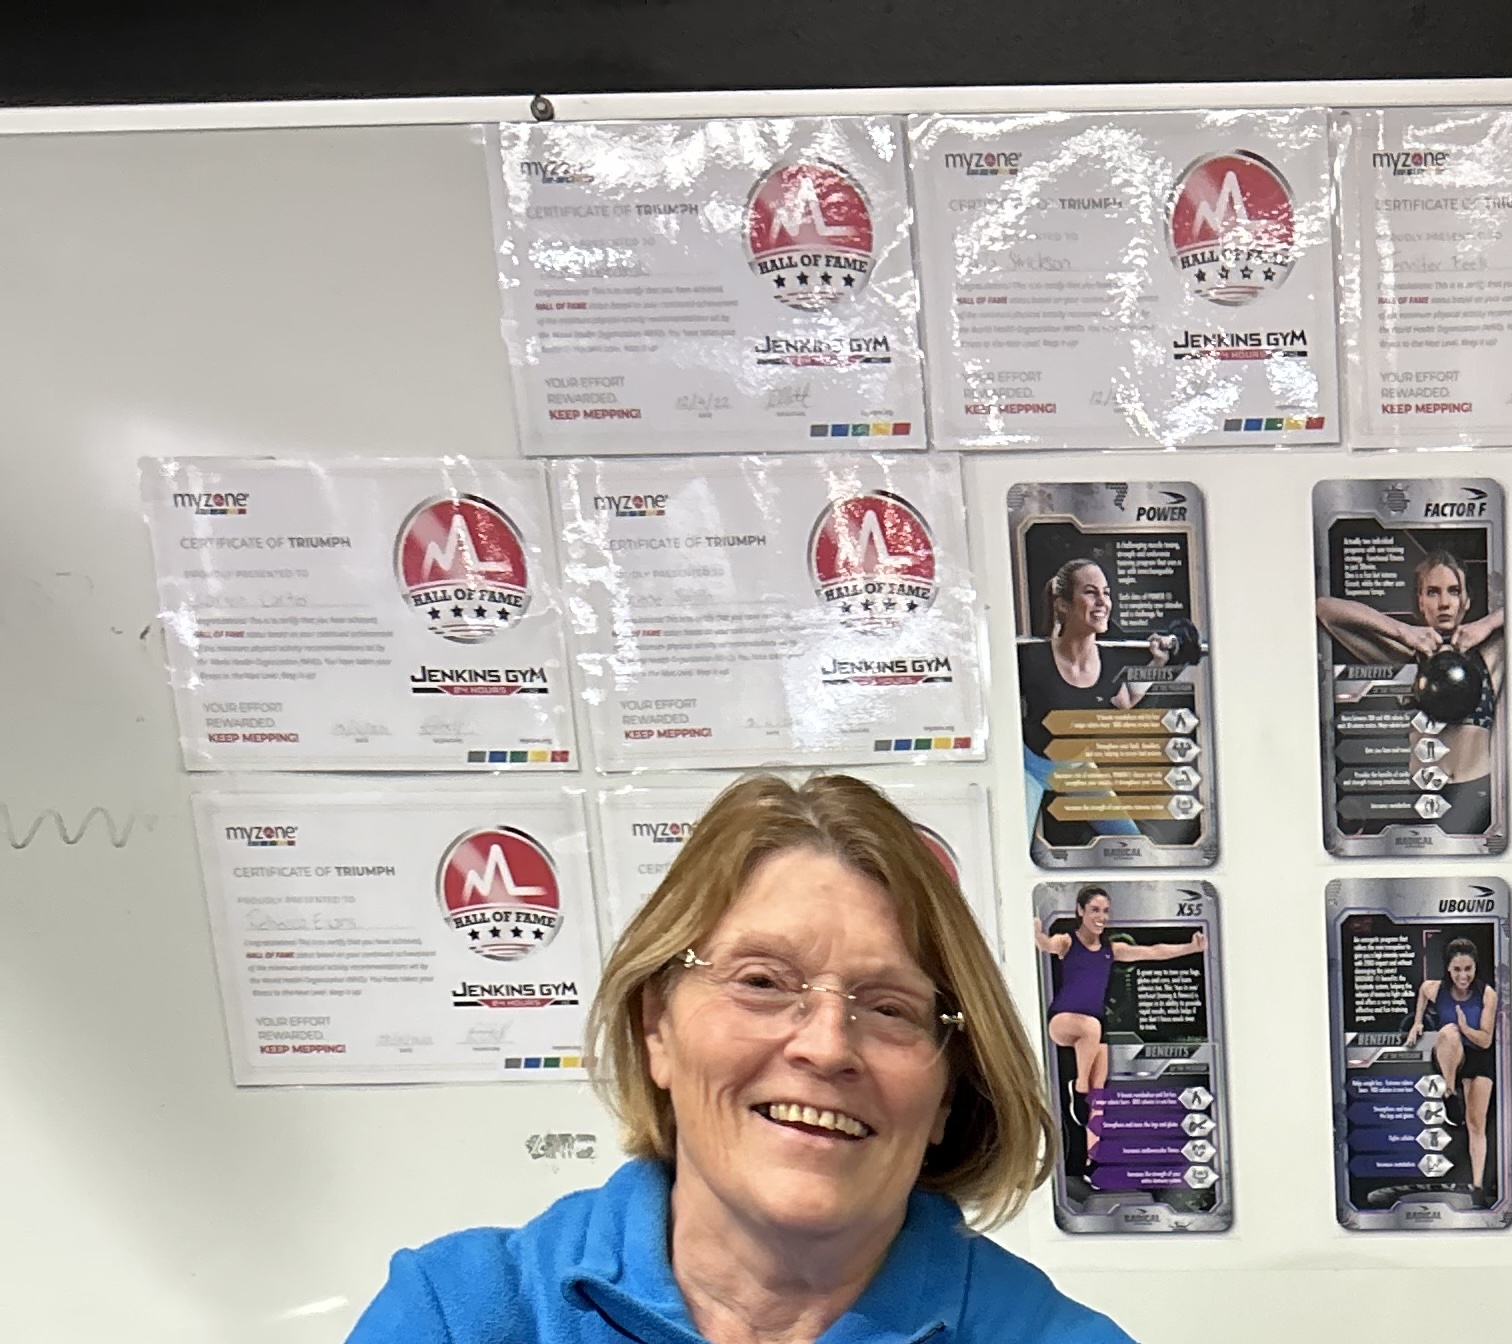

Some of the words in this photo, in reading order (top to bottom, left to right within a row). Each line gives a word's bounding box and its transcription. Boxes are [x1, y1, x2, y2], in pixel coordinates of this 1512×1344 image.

[758, 258, 797, 274] HALL
[801, 255, 821, 267] OF
[825, 255, 868, 272] FAME
[849, 336, 891, 352] GYM
[1173, 331, 1262, 348] JENKINS
[1266, 330, 1307, 347] GYM
[549, 409, 590, 421] KEEP
[595, 408, 642, 420] MEPPING!
[1381, 403, 1412, 414] KEEP
[1416, 402, 1472, 414] MEPPING!
[173, 493, 250, 510] myzone
[1136, 507, 1186, 521] POWER
[1424, 503, 1475, 517] FACTOR
[1479, 503, 1486, 517] F
[413, 590, 451, 607] HALL
[454, 588, 476, 600] OF
[479, 590, 522, 607] FAME
[821, 659, 908, 675] JENKINS
[912, 658, 951, 673] GYM
[1127, 667, 1174, 680] BENEFITS
[1347, 665, 1394, 679] BENEFITS
[411, 666, 501, 683] JENKINS
[505, 666, 548, 683] GYM
[208, 733, 238, 743] KEEP
[242, 733, 299, 743] MEPPING!
[624, 729, 653, 739] KEEP
[657, 728, 712, 739] MEPPING!
[226, 825, 298, 843] myzone
[633, 822, 692, 842] myzon
[234, 867, 312, 879] CERTIFICATE
[316, 867, 333, 877] OF
[336, 865, 395, 877] TRIUMPH
[1176, 904, 1203, 916] X55
[1438, 900, 1494, 913] UBOUND
[454, 913, 490, 929] HALL
[493, 911, 512, 922] OF
[514, 913, 556, 928] FAME
[452, 983, 536, 998] JENKINS
[540, 982, 577, 996] GYM
[256, 1017, 288, 1027] YOUR
[290, 1017, 331, 1026] EFFORT
[1357, 1033, 1403, 1046] BENEFITS
[260, 1045, 289, 1055] KEEP
[292, 1044, 346, 1054] MEPPING!
[1144, 1046, 1189, 1059] BENEFITS
